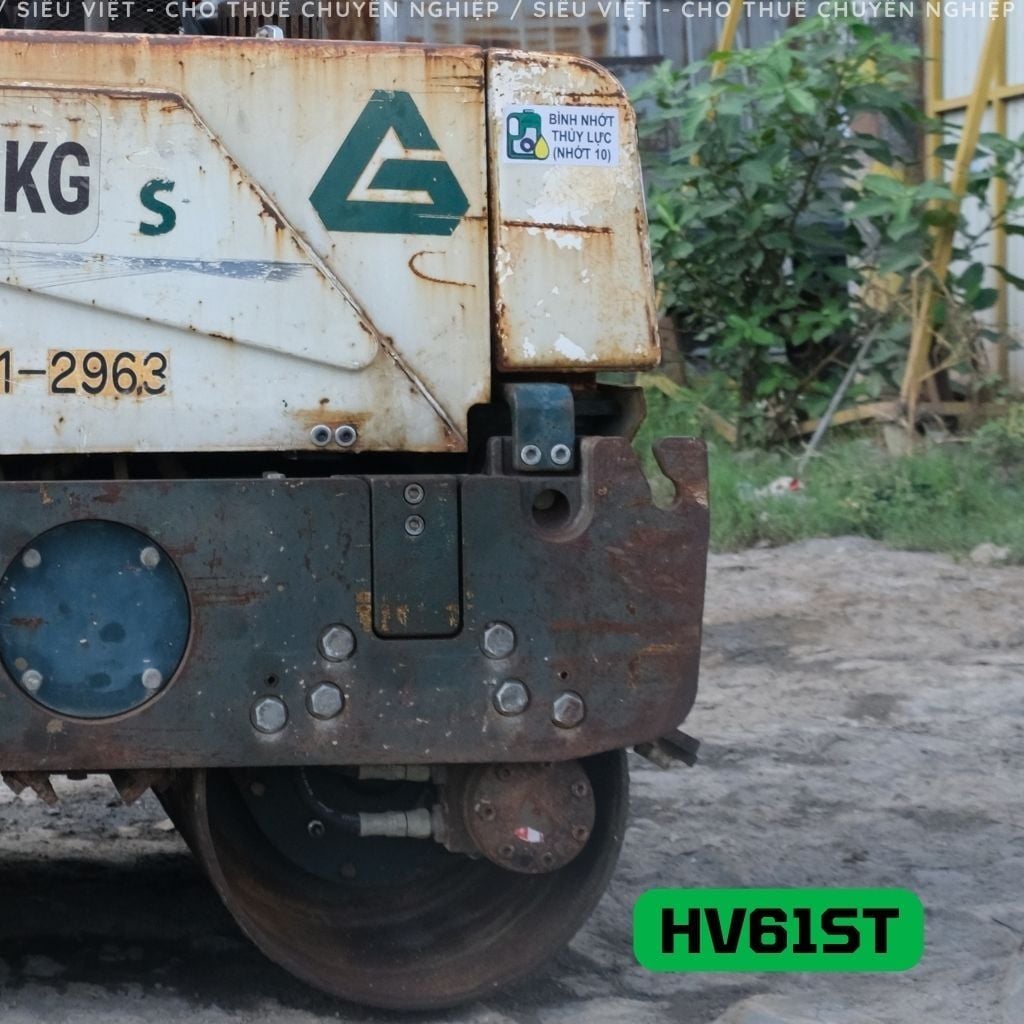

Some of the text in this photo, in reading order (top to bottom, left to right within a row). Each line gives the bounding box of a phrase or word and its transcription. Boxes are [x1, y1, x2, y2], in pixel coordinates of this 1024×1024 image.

[549, 111, 615, 127] BÌNH NHỚT
[552, 127, 612, 146] THỦY LỰC
[553, 145, 611, 163] (NHỚT 10)
[4, 140, 91, 216] KG
[139, 177, 177, 237] S
